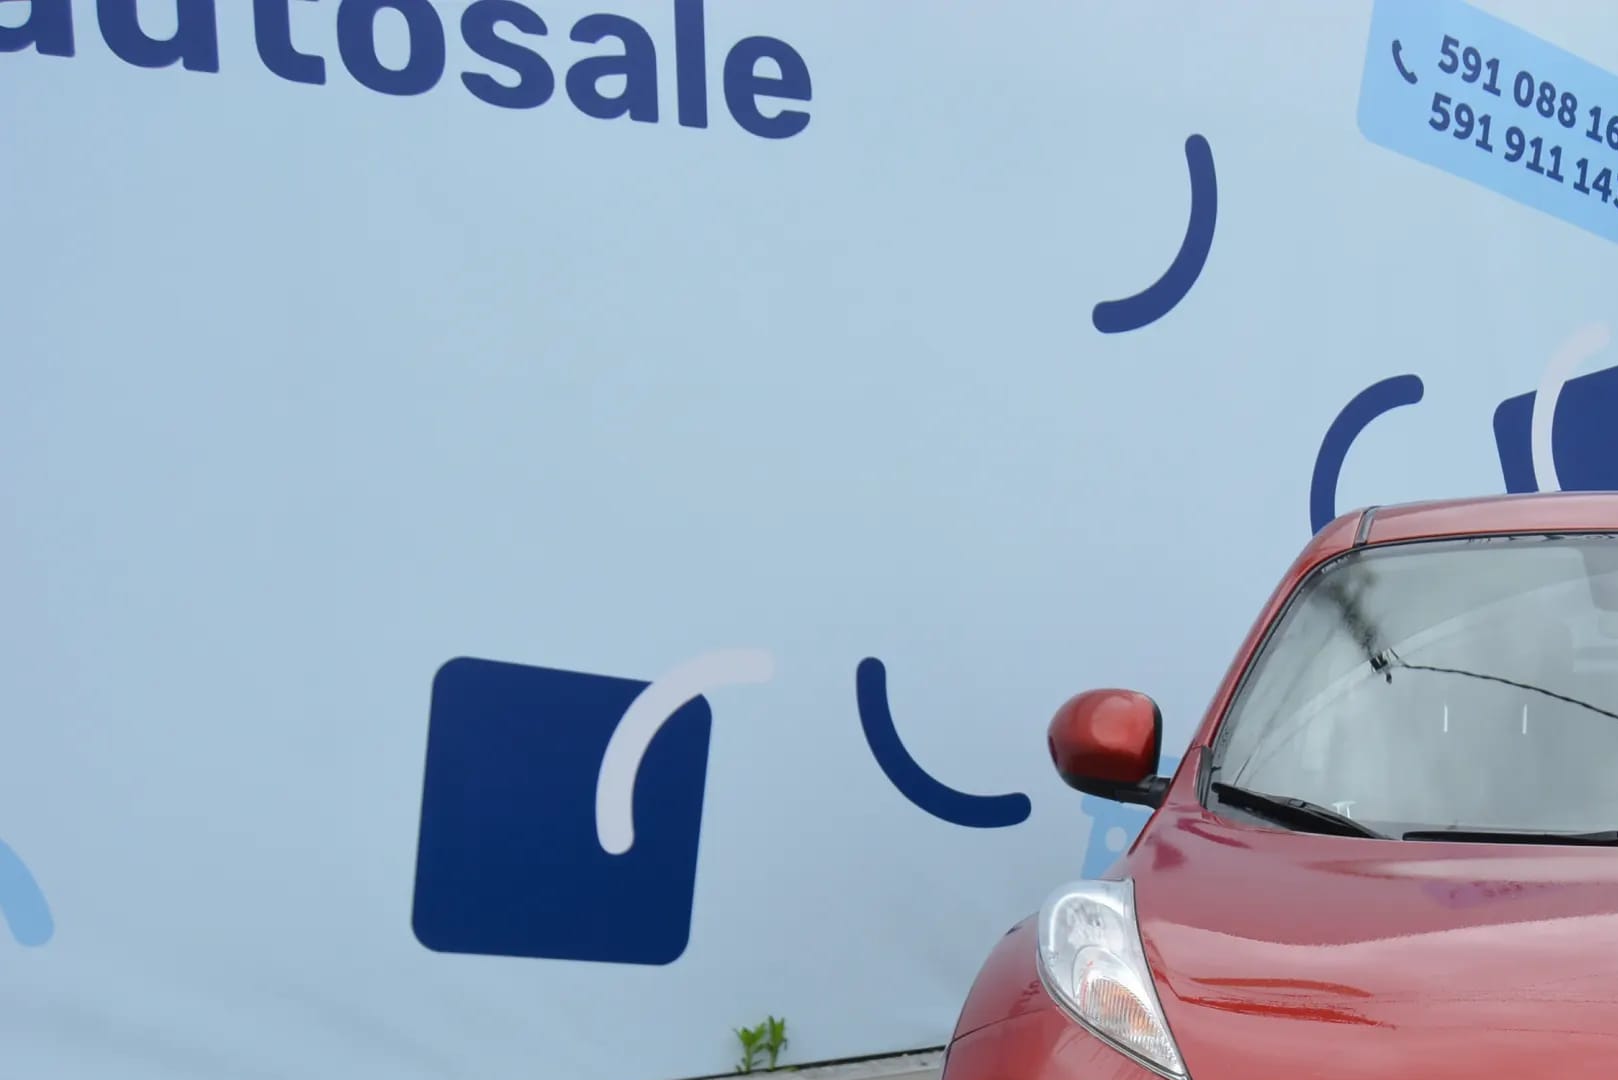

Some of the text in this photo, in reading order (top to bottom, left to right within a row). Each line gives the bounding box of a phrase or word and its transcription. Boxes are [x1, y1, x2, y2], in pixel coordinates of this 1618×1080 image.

[1437, 34, 1502, 98] 591
[1513, 70, 1578, 129] 088
[1428, 91, 1494, 154] 591
[1503, 125, 1565, 184] 911
